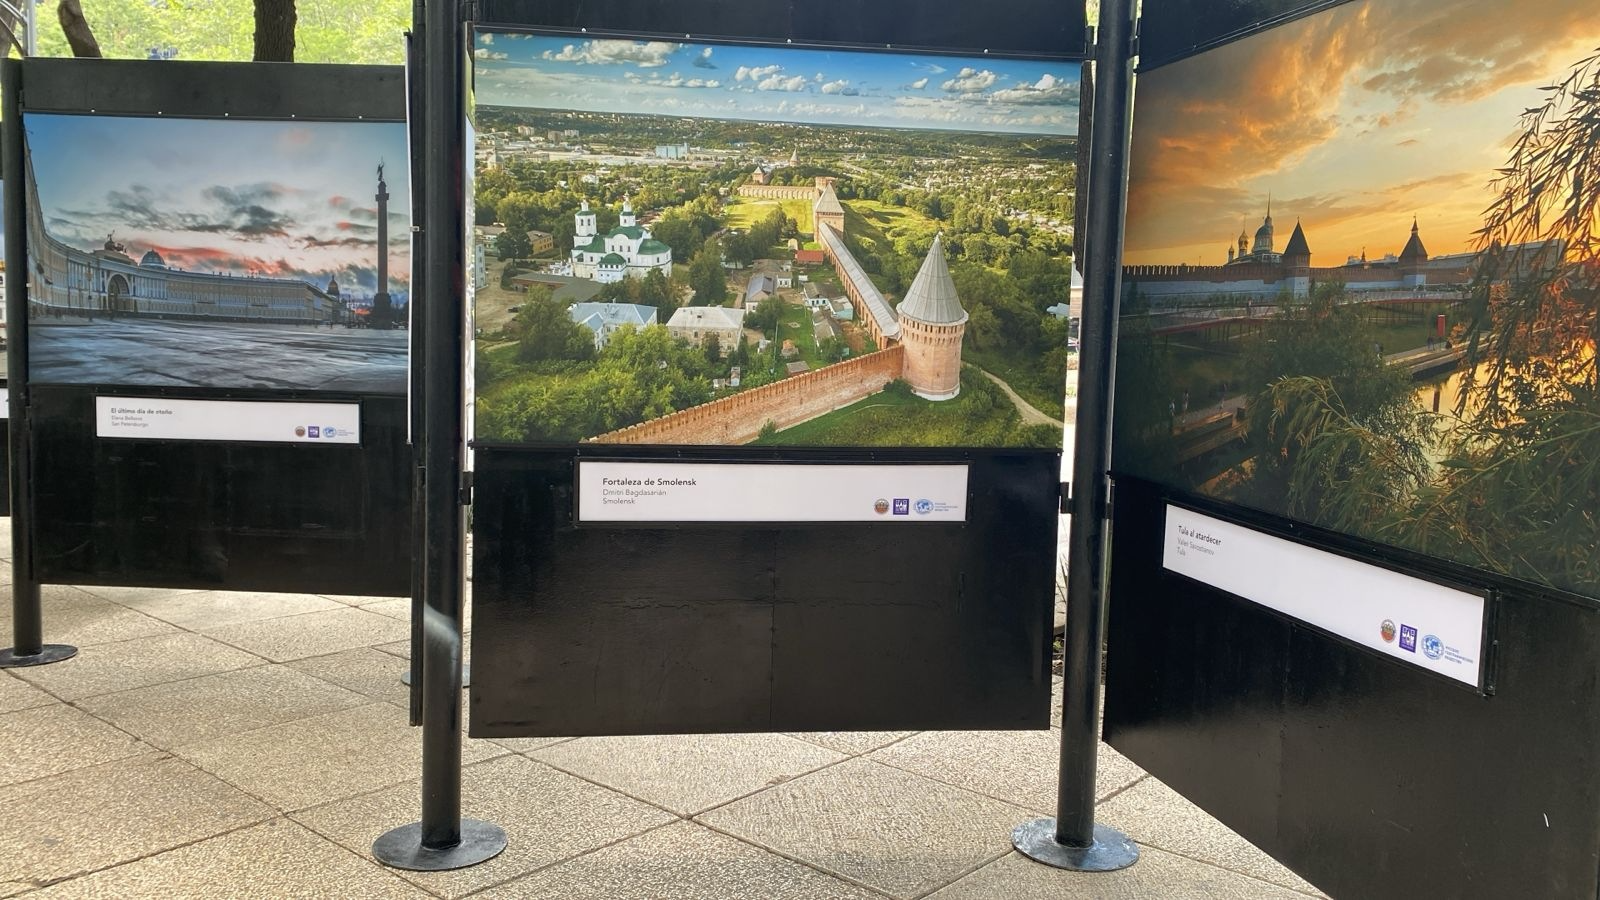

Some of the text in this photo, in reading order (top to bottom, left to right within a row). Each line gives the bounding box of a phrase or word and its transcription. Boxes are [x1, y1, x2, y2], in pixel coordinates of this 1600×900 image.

[602, 477, 697, 486] Fortaleza de Smolensk
[602, 488, 624, 496] Dmitri
[602, 497, 636, 505] Smolensk
[1178, 525, 1222, 546] Tula al atardecer
